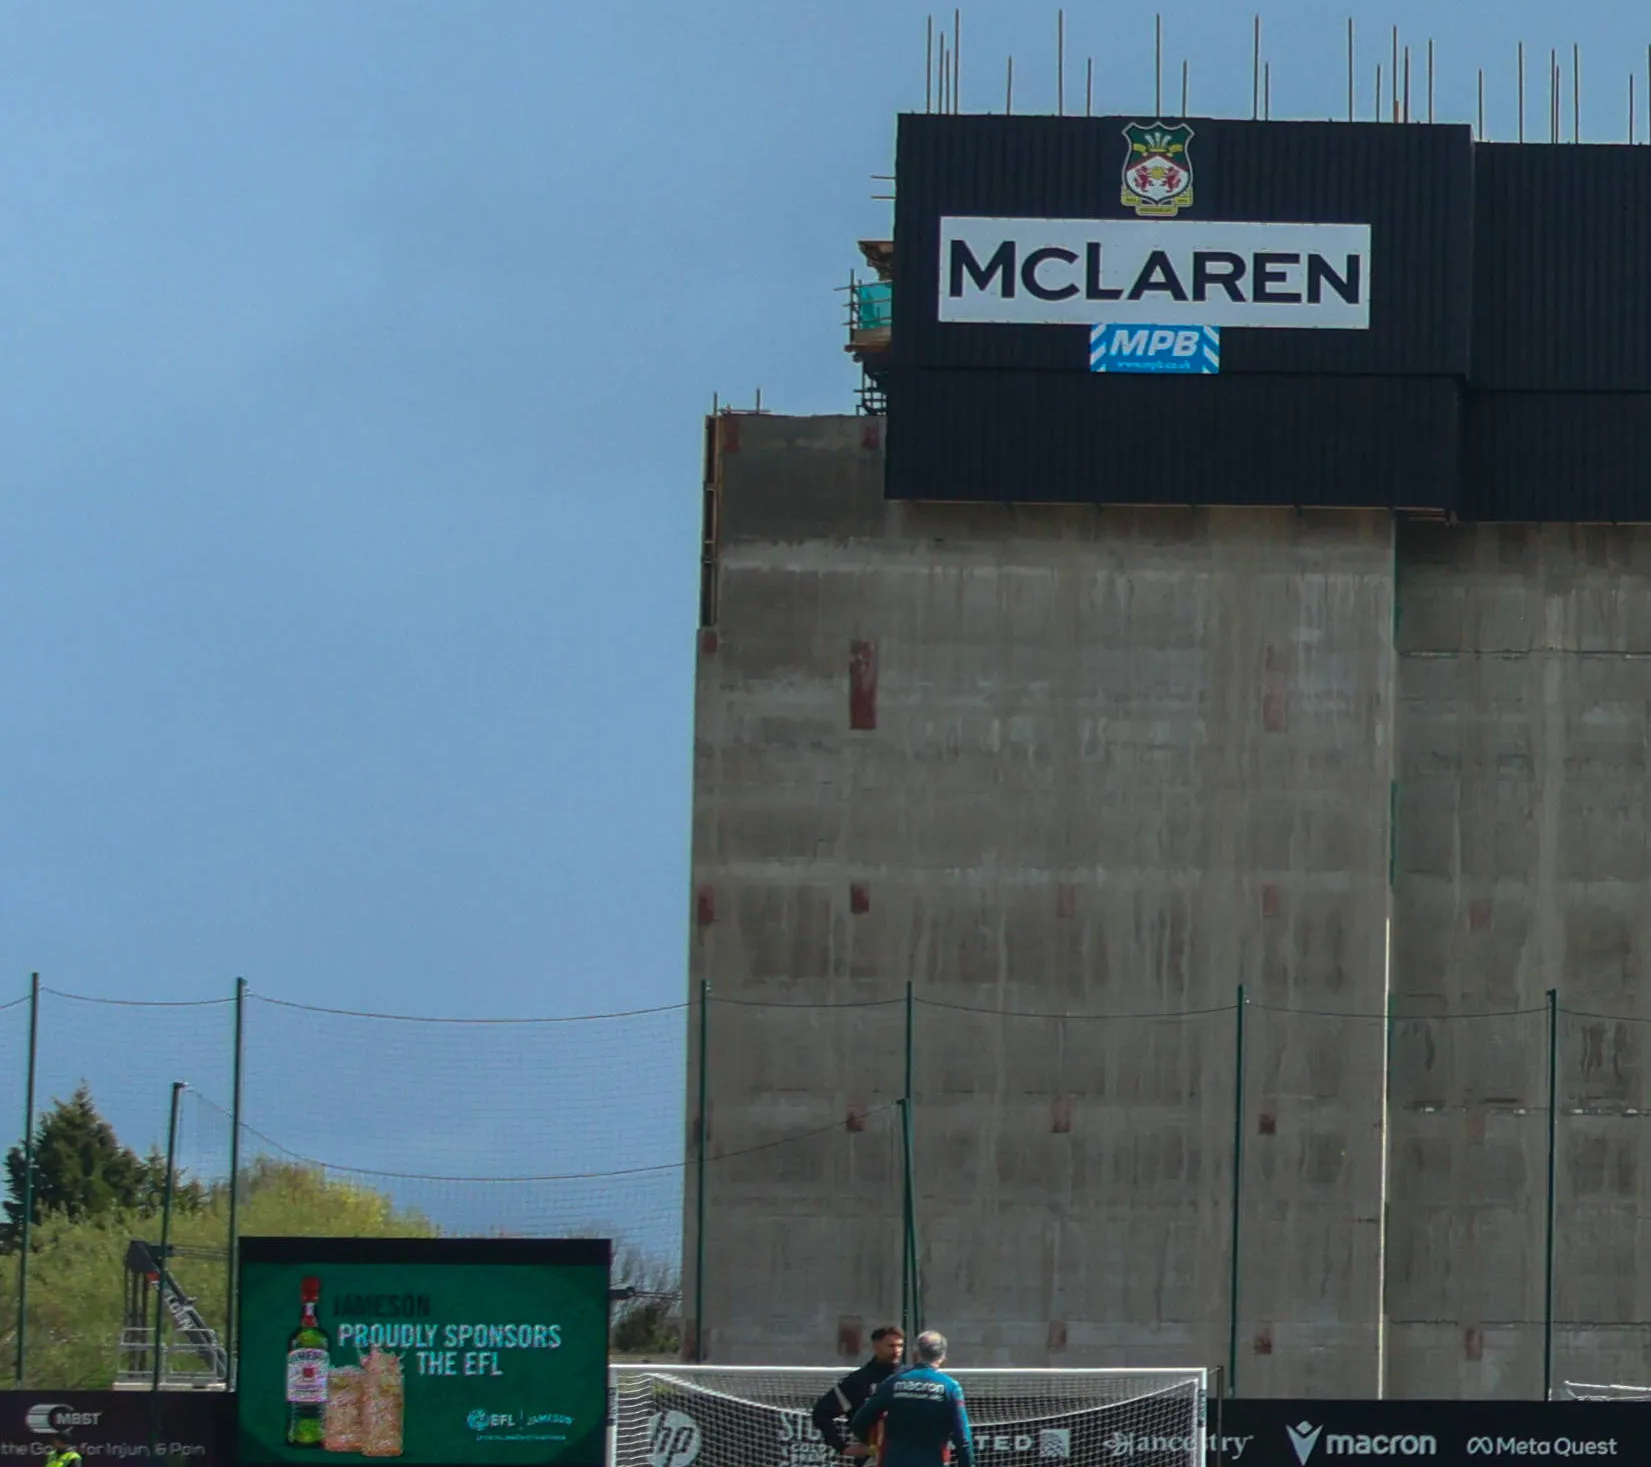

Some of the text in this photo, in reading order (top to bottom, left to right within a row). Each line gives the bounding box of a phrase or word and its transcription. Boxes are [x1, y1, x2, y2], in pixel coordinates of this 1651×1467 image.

[1109, 330, 1200, 357] MPB
[332, 1294, 431, 1317] JAMESON
[338, 1323, 562, 1349] PROUDLY SPONSORS
[416, 1351, 504, 1376] THE EFL
[893, 1381, 945, 1393] macron
[490, 1413, 516, 1427] EFL
[1325, 1434, 1437, 1456] macron
[1496, 1437, 1618, 1458] Meta Quest
